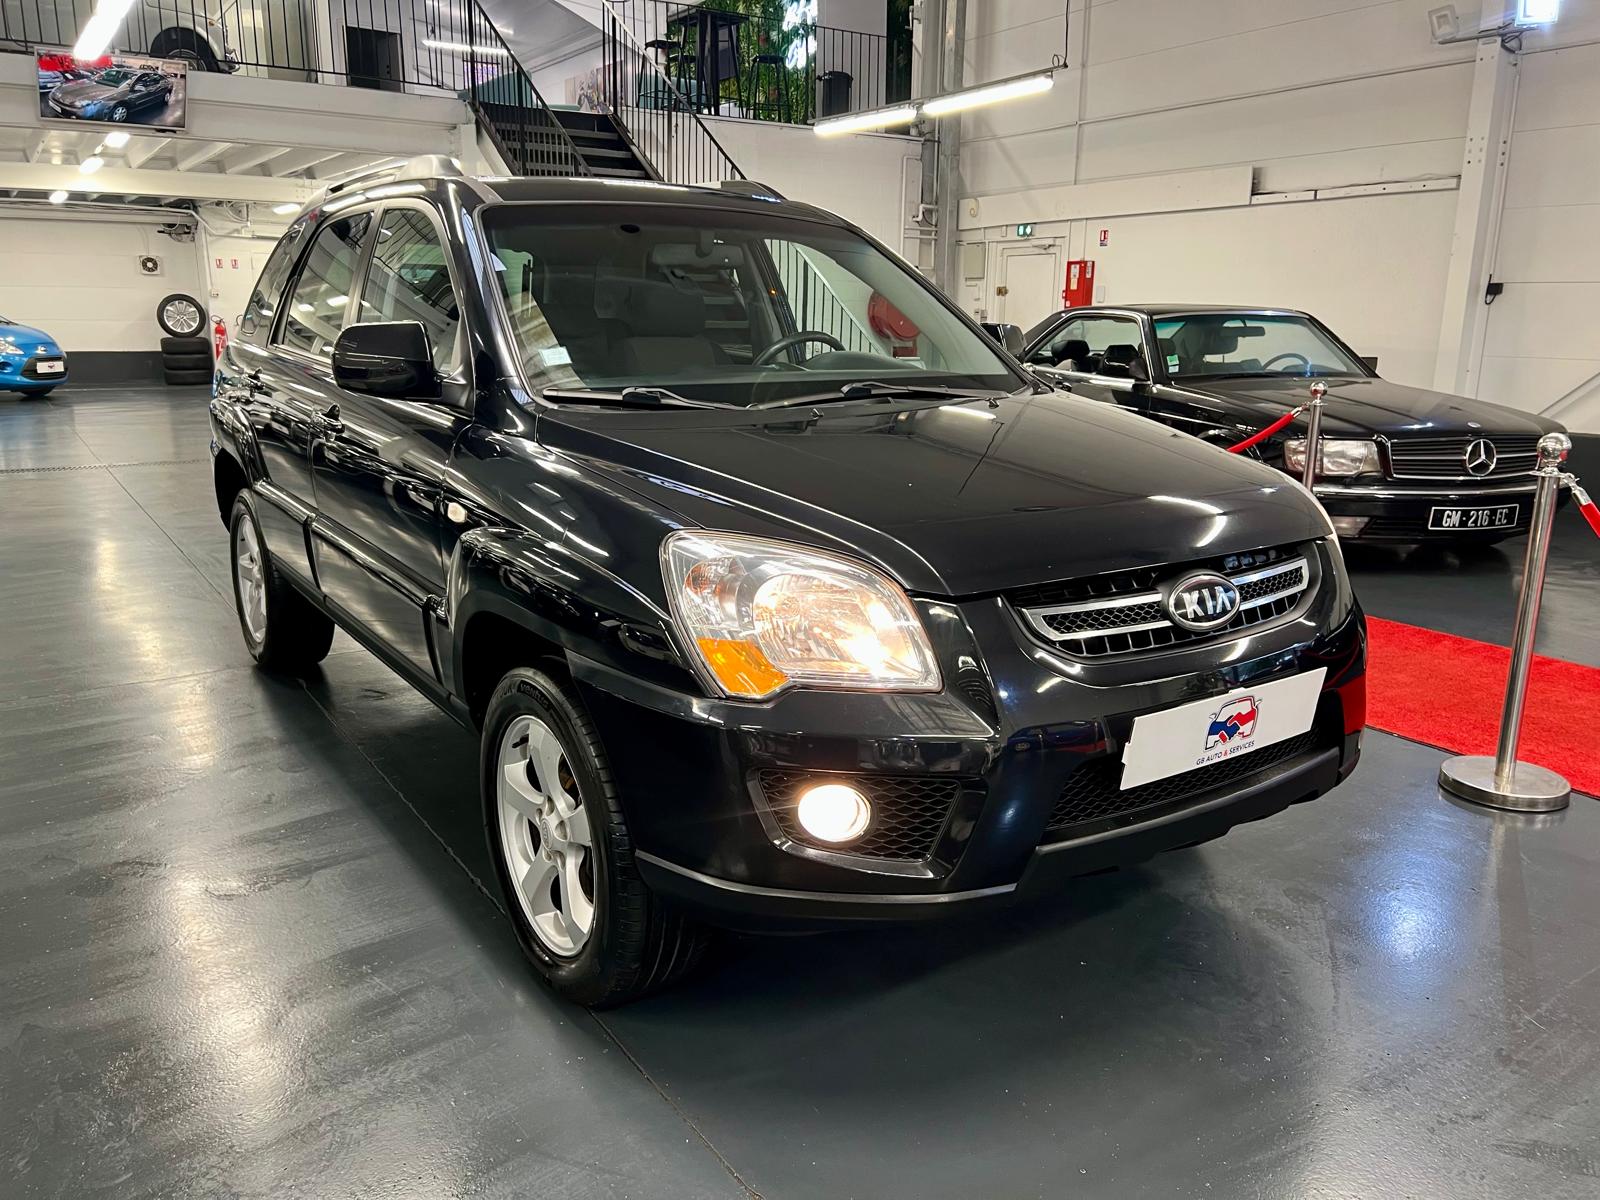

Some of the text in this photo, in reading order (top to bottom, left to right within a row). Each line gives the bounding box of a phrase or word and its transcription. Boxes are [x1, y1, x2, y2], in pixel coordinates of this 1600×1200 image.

[1180, 585, 1232, 619] KIA
[1196, 740, 1255, 766] GB AUTO & SERVICES
